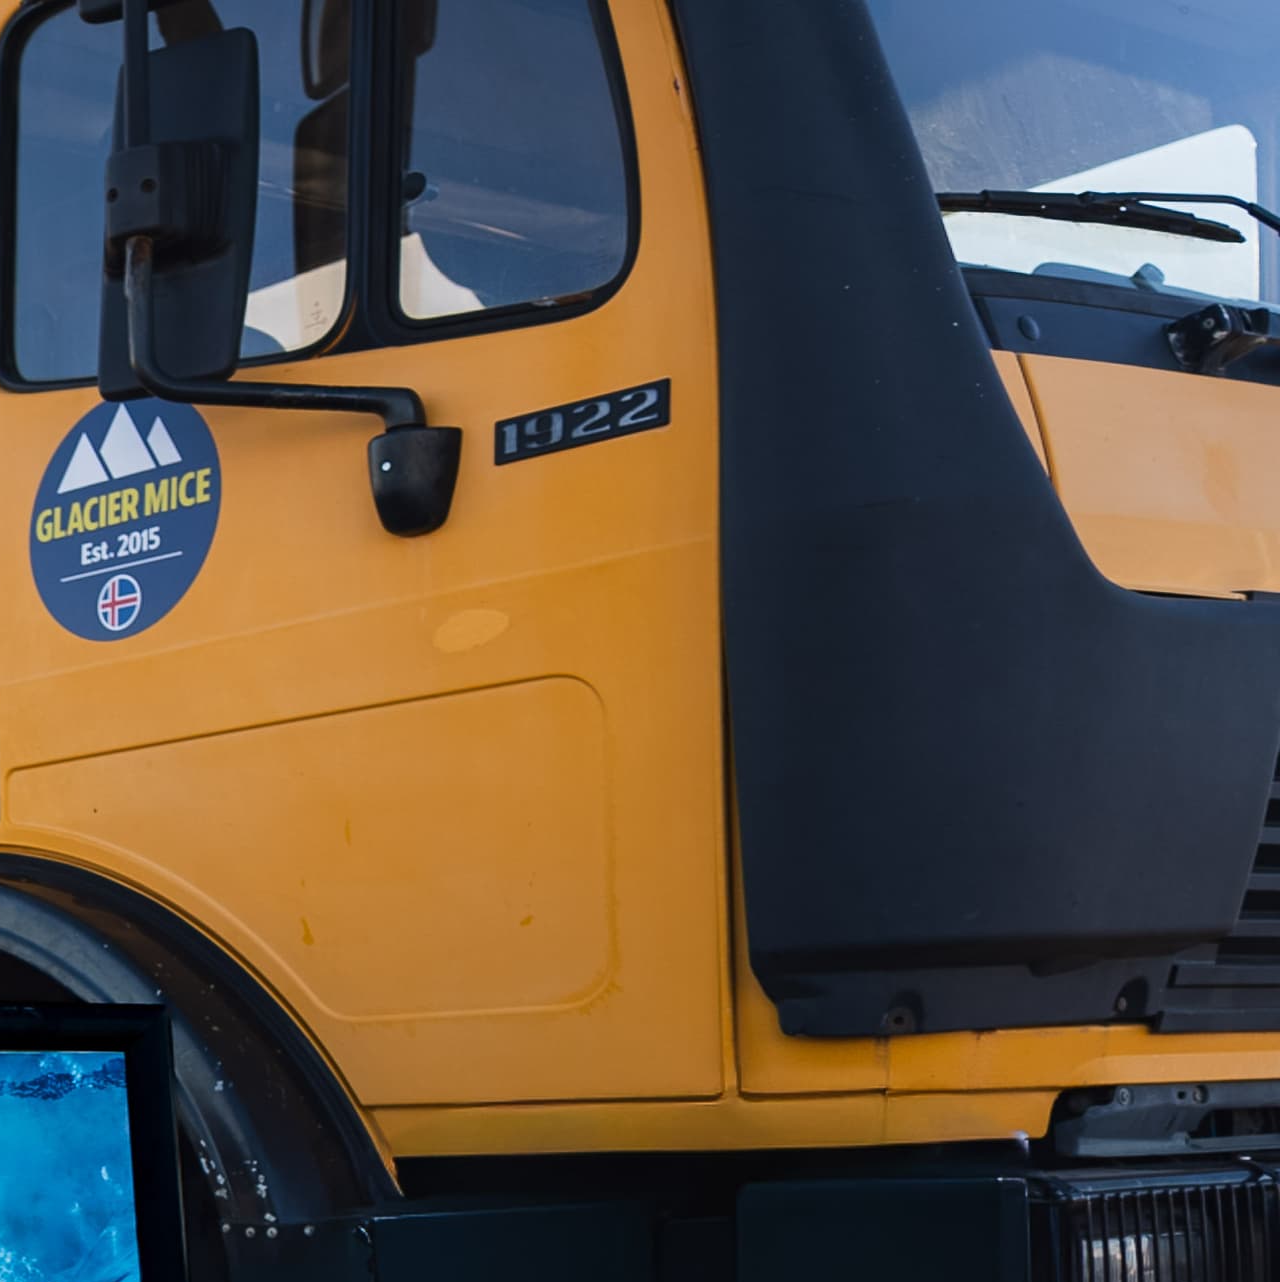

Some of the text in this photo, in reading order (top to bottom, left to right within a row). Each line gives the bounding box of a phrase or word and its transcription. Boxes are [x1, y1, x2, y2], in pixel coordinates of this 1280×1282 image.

[501, 387, 660, 455] 1922
[35, 467, 211, 543] GLACIER MICE
[81, 526, 161, 566] Est. 2015
